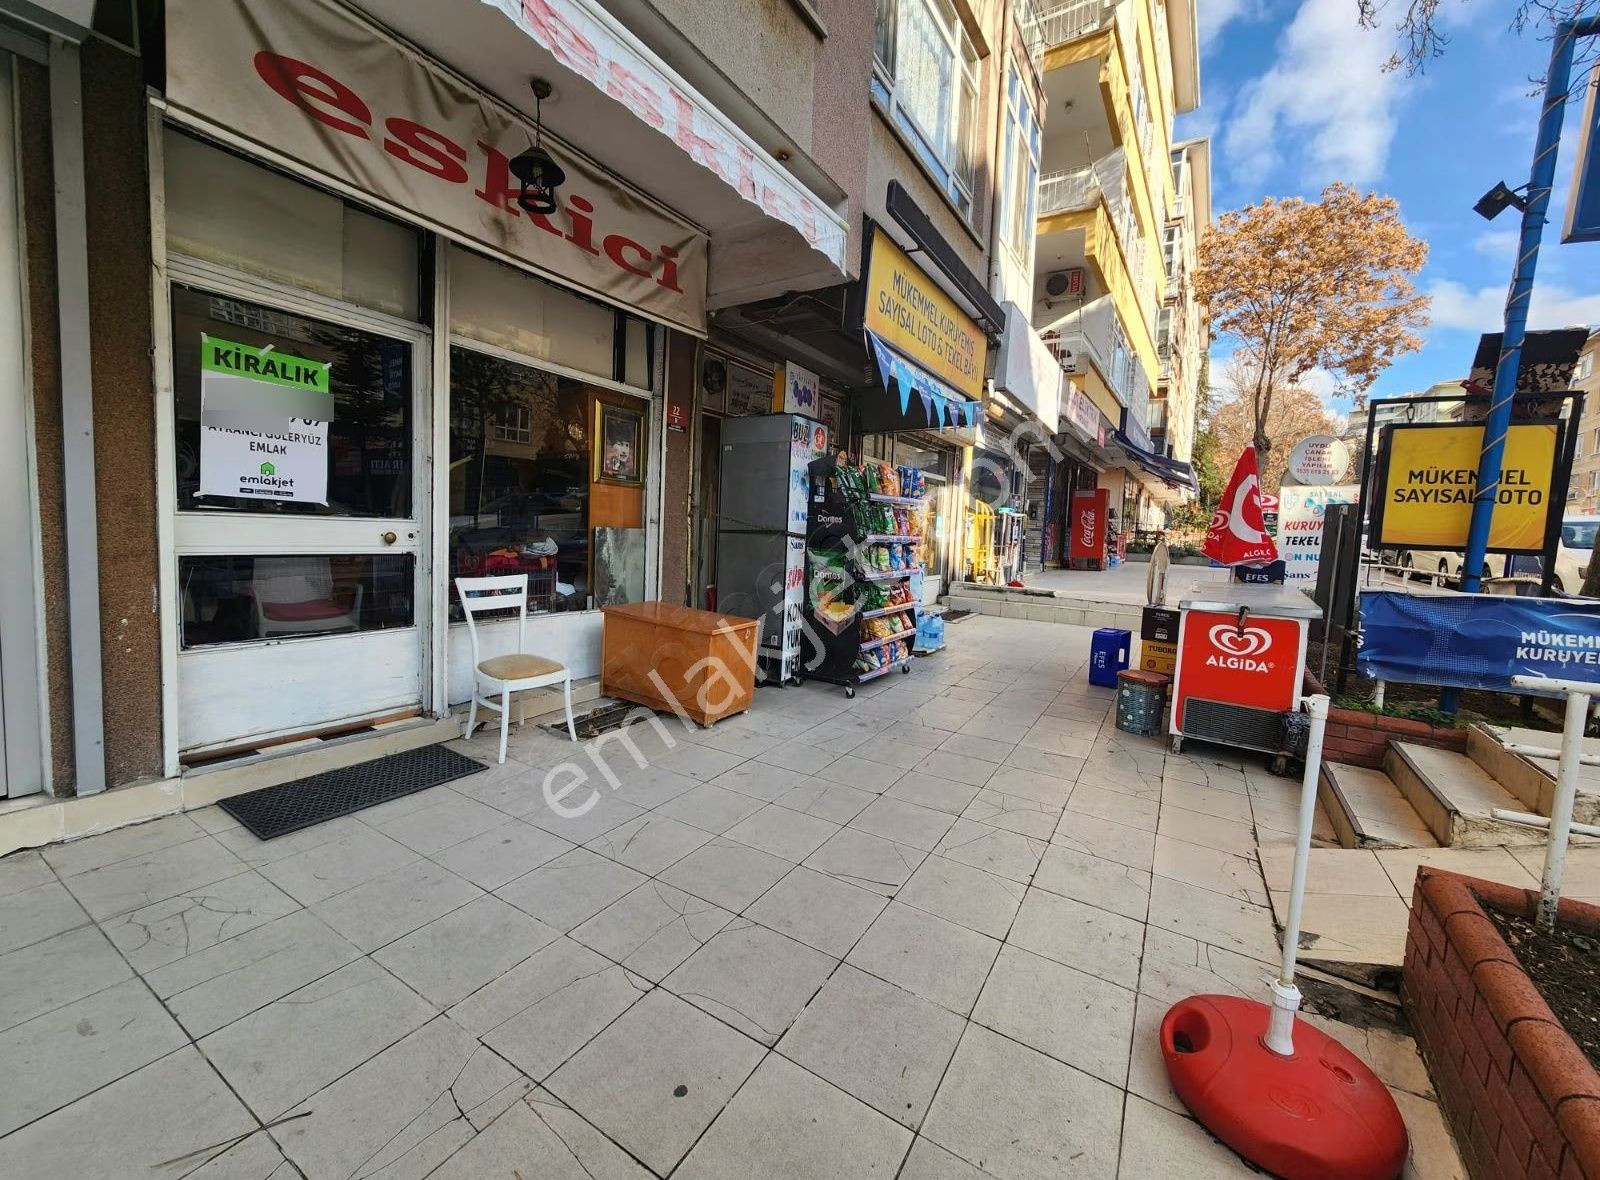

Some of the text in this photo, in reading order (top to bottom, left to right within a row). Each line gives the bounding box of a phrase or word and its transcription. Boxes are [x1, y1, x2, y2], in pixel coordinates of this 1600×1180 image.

[255, 50, 684, 295] eskici
[878, 290, 915, 336] SAYISAL
[917, 323, 937, 351] LOTO
[214, 346, 320, 387] KİRALIK
[672, 405, 680, 416] 22
[250, 441, 288, 455] EMLAK
[240, 474, 295, 488] emlakjet
[1407, 466, 1531, 485] MÜKEMEL
[1393, 488, 1542, 506] SAYISAL OTO
[817, 514, 843, 525] Doritos
[1285, 536, 1320, 546] TEKEL
[1245, 573, 1269, 582] EFES
[1099, 650, 1107, 669] EFES
[1515, 646, 1600, 665] KURUYE
